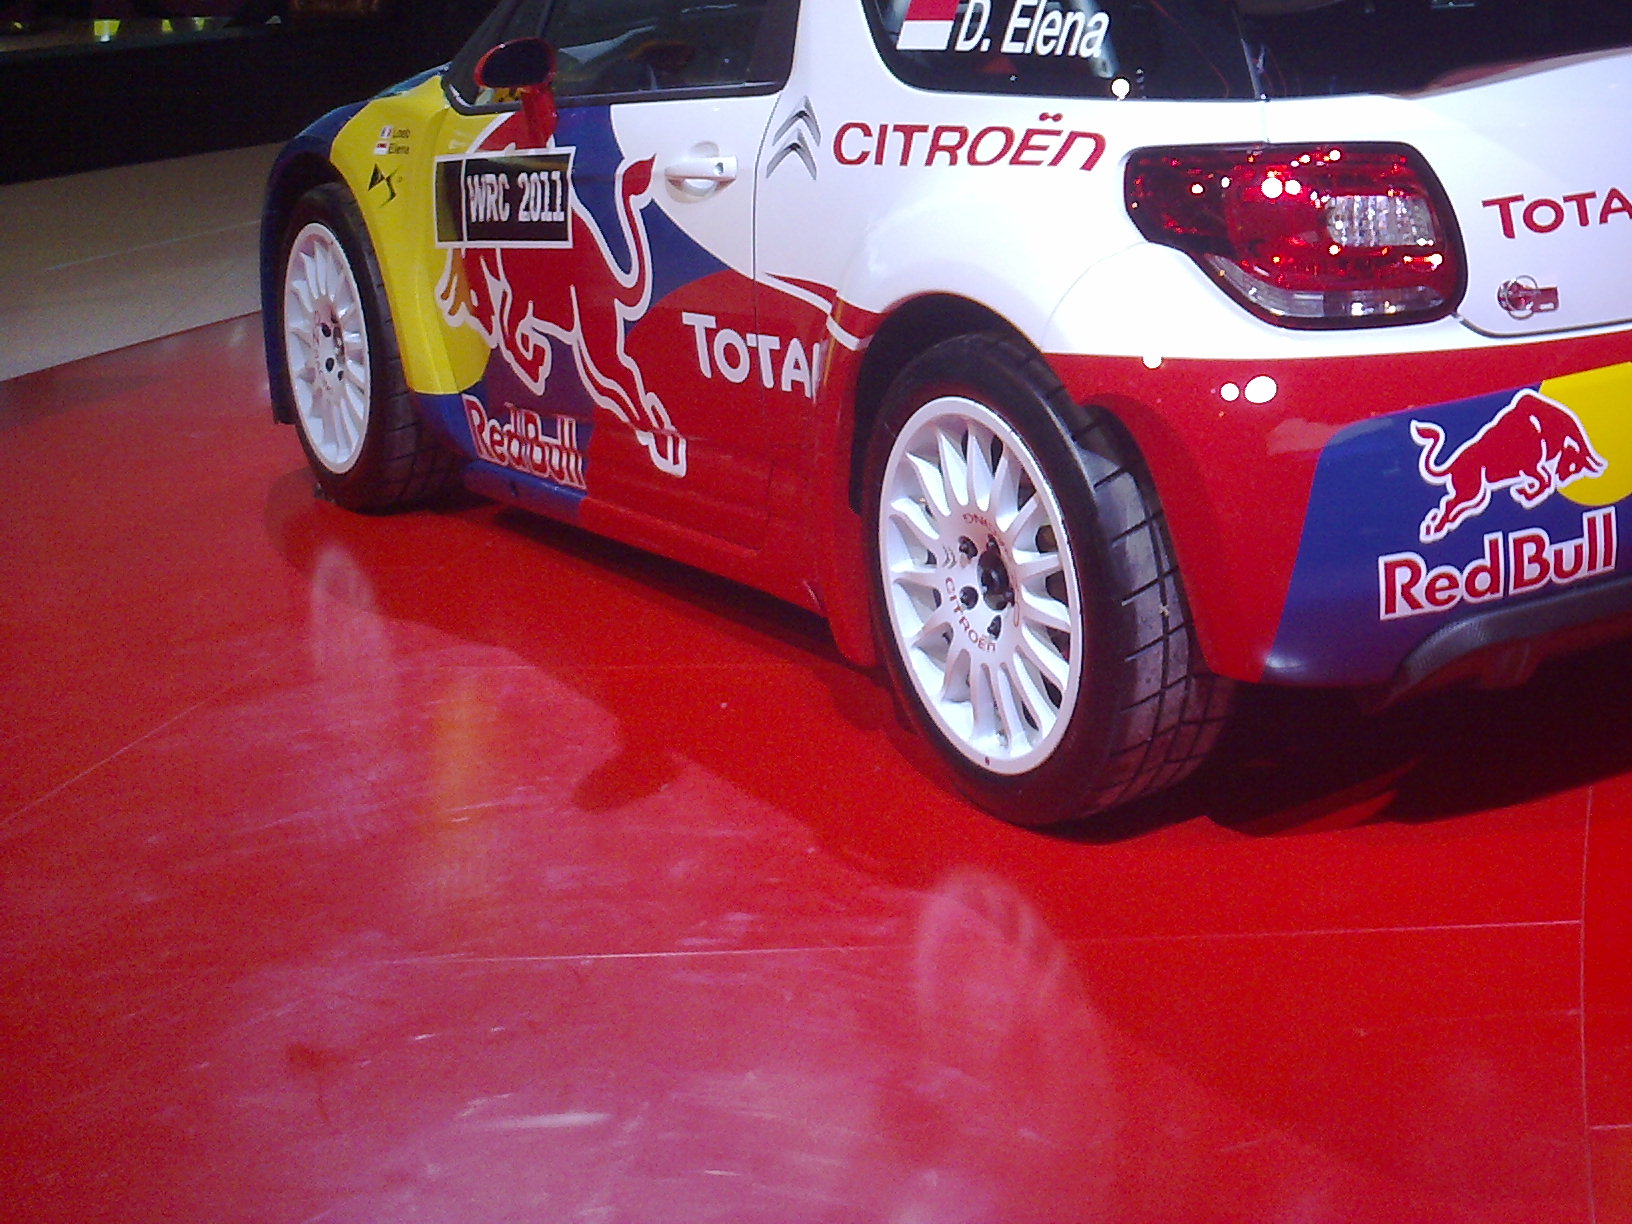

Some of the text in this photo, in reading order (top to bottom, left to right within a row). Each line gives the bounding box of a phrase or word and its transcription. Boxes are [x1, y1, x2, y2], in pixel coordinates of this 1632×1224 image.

[466, 170, 565, 223] WRC 2011
[1379, 507, 1617, 620] Red Bull
